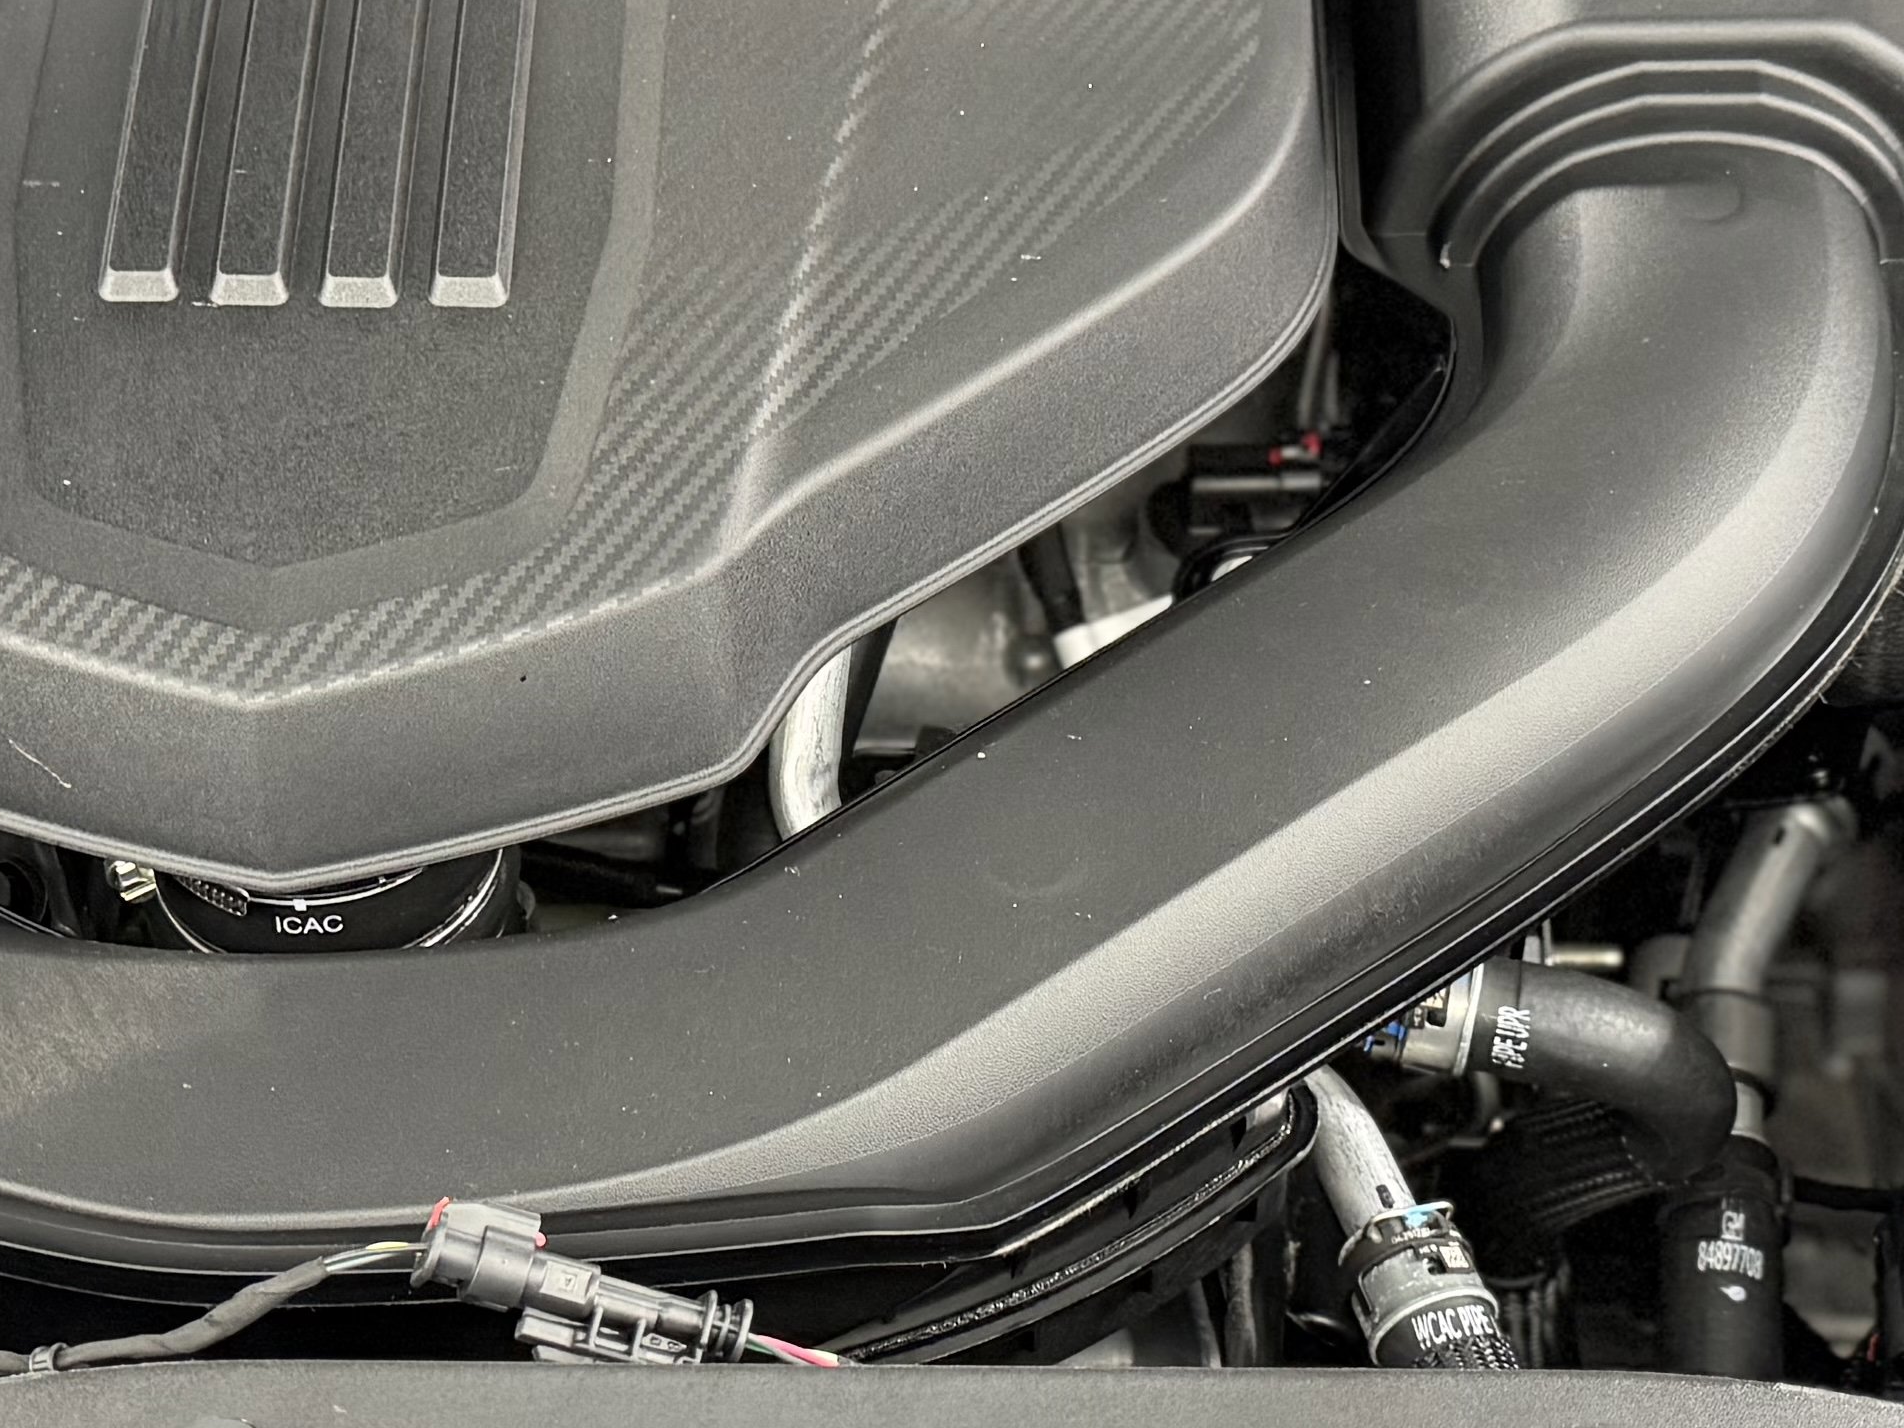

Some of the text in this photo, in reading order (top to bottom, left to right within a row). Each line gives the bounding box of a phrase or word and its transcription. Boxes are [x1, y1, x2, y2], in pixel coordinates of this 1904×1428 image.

[275, 915, 344, 935] ICAC
[1497, 1005, 1531, 1043] UPR
[1411, 1304, 1494, 1350] WCAC PIPE
